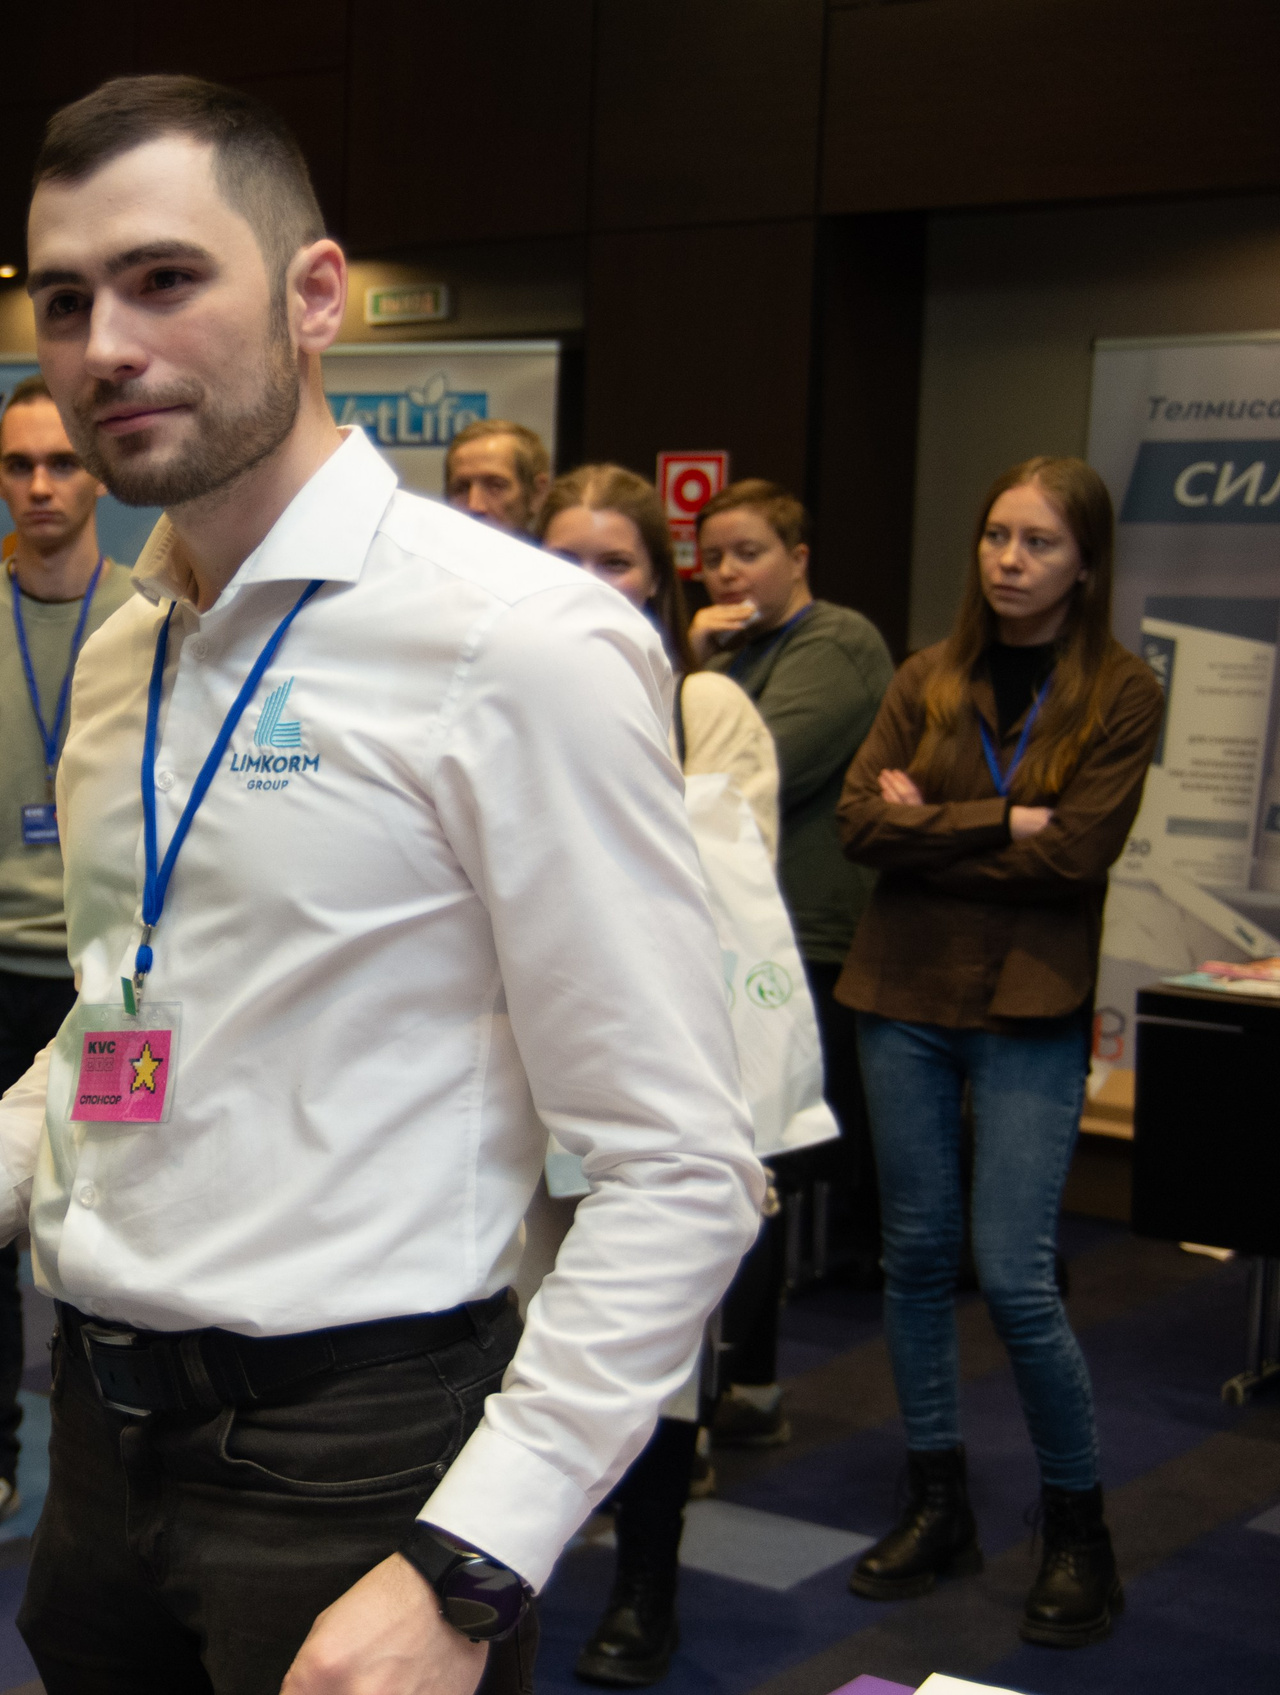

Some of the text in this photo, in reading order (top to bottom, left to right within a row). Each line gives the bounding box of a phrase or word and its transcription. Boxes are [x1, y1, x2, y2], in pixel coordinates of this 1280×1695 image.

[230, 753, 320, 773] LIMKORM
[247, 779, 289, 791] GROUP
[88, 1041, 116, 1054] KVC
[80, 1095, 122, 1105] СПОНСОР
